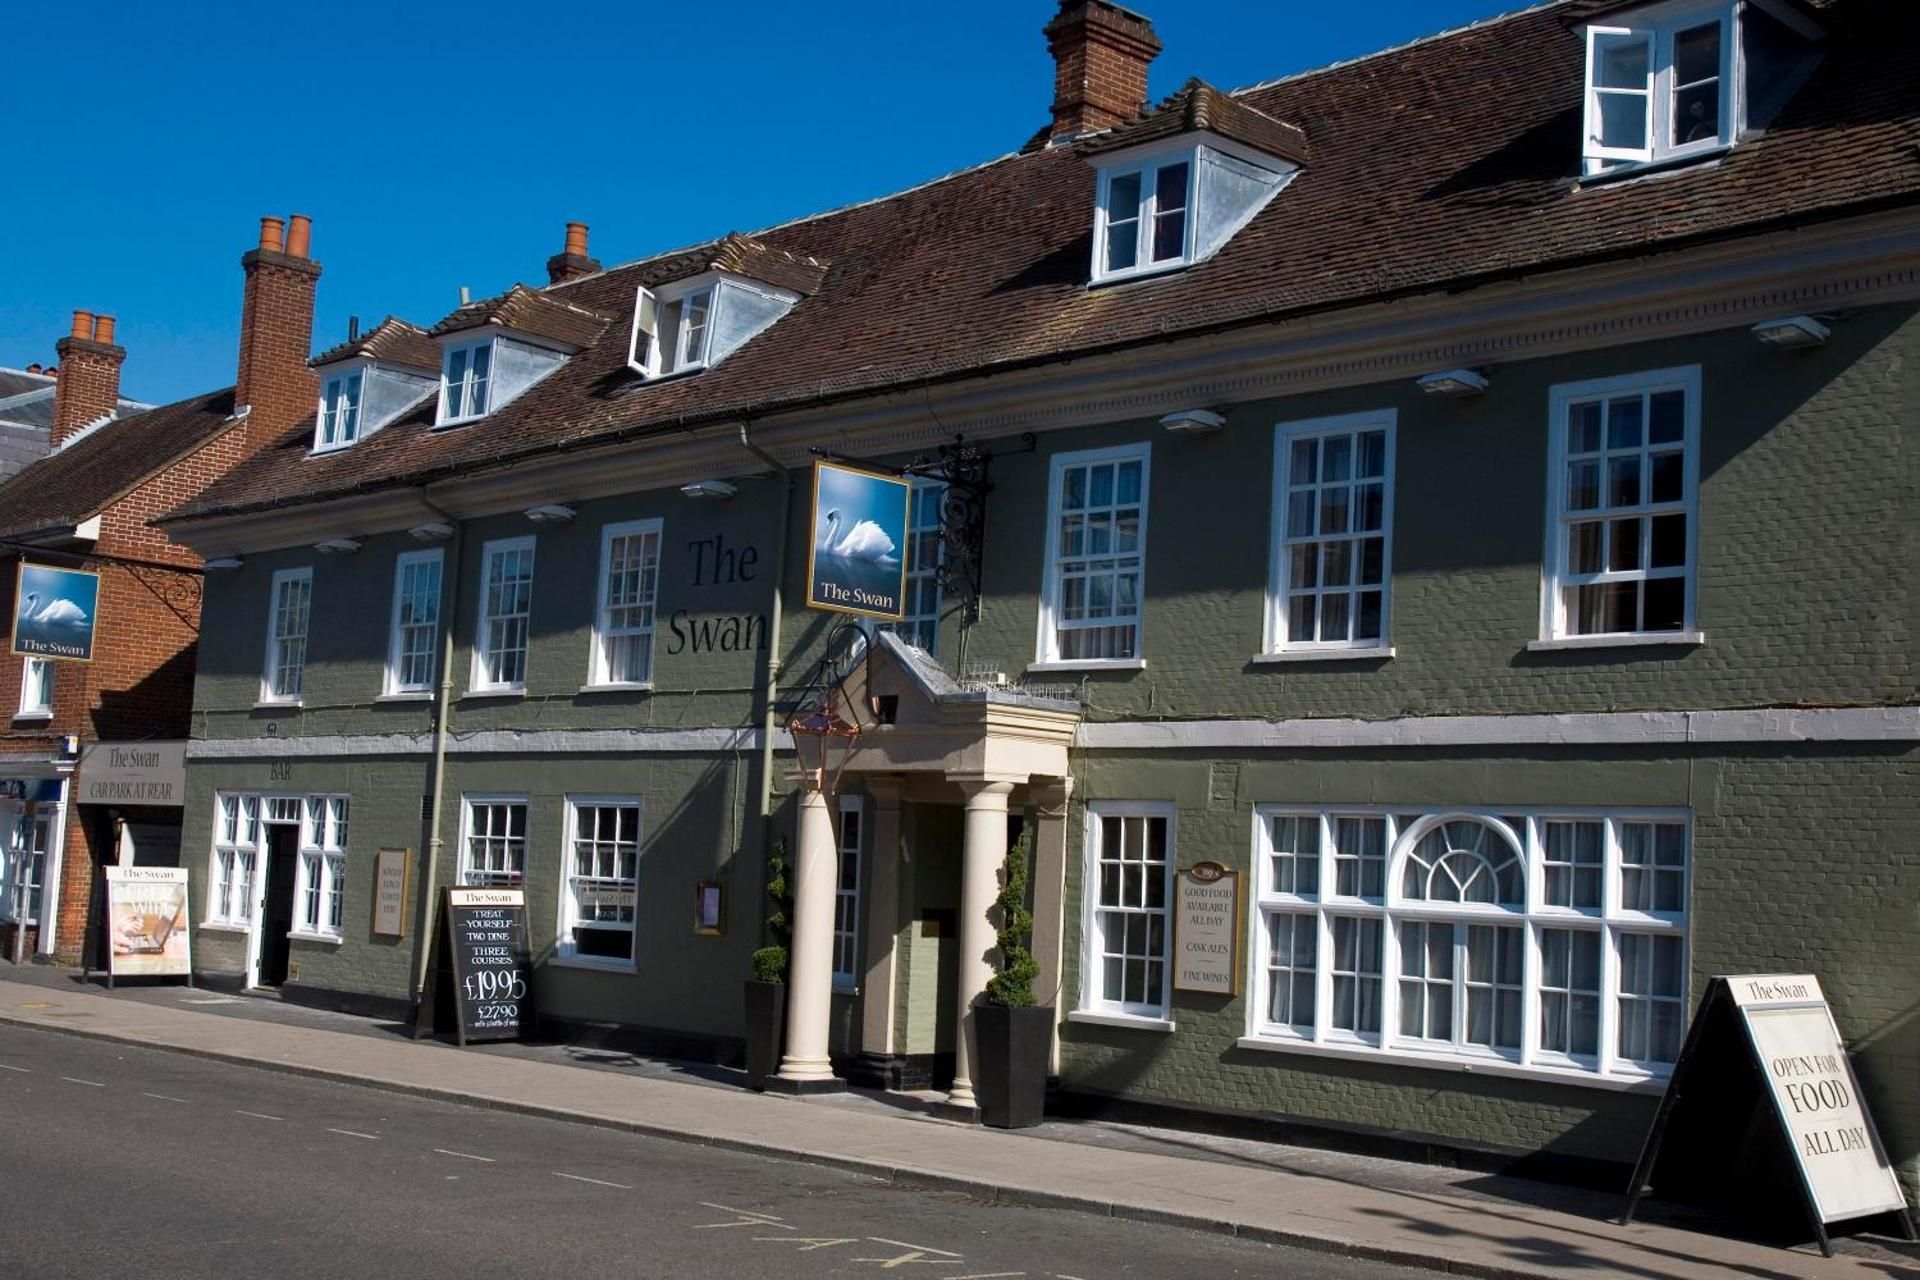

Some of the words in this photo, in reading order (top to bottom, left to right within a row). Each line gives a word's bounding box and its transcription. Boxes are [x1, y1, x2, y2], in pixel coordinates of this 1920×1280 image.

[687, 533, 758, 587] The
[821, 582, 850, 601] The
[852, 588, 893, 608] Swan
[667, 608, 768, 655] Swan
[22, 639, 47, 651] The
[49, 641, 84, 655] Swan
[109, 747, 128, 768] The
[129, 747, 160, 768] Swan
[270, 761, 291, 780] BAR
[90, 782, 107, 799] CAR
[107, 782, 132, 799] PARK
[132, 782, 146, 799] AT
[147, 782, 173, 800] REAR
[124, 869, 142, 878] The
[145, 871, 174, 879] Swan
[466, 893, 484, 902] The
[485, 893, 512, 902] Swan
[1184, 886, 1208, 898] GOOD
[1208, 887, 1232, 899] FOOD
[1186, 901, 1230, 912] AVAILABLE
[472, 910, 504, 918] TREAT
[1190, 914, 1207, 925] ALL
[1207, 915, 1225, 927] DAY
[466, 920, 513, 928] YOURSELF
[466, 932, 486, 941] TWO
[487, 932, 510, 941] DINE
[472, 946, 508, 956] THREE
[1185, 942, 1207, 953] CASK
[1207, 943, 1229, 954] ALES
[471, 956, 513, 965] COURSES
[1183, 970, 1202, 981] FINE
[1202, 971, 1230, 983] WINES
[463, 970, 526, 1000] £19.95
[1746, 980, 1773, 1000] The
[1773, 981, 1808, 999] Swan
[1773, 1055, 1814, 1078] OPEN
[1813, 1054, 1841, 1073] FOR
[1785, 1079, 1849, 1113] FOOD
[1804, 1130, 1840, 1156] ALL
[1837, 1127, 1867, 1151] DAY
